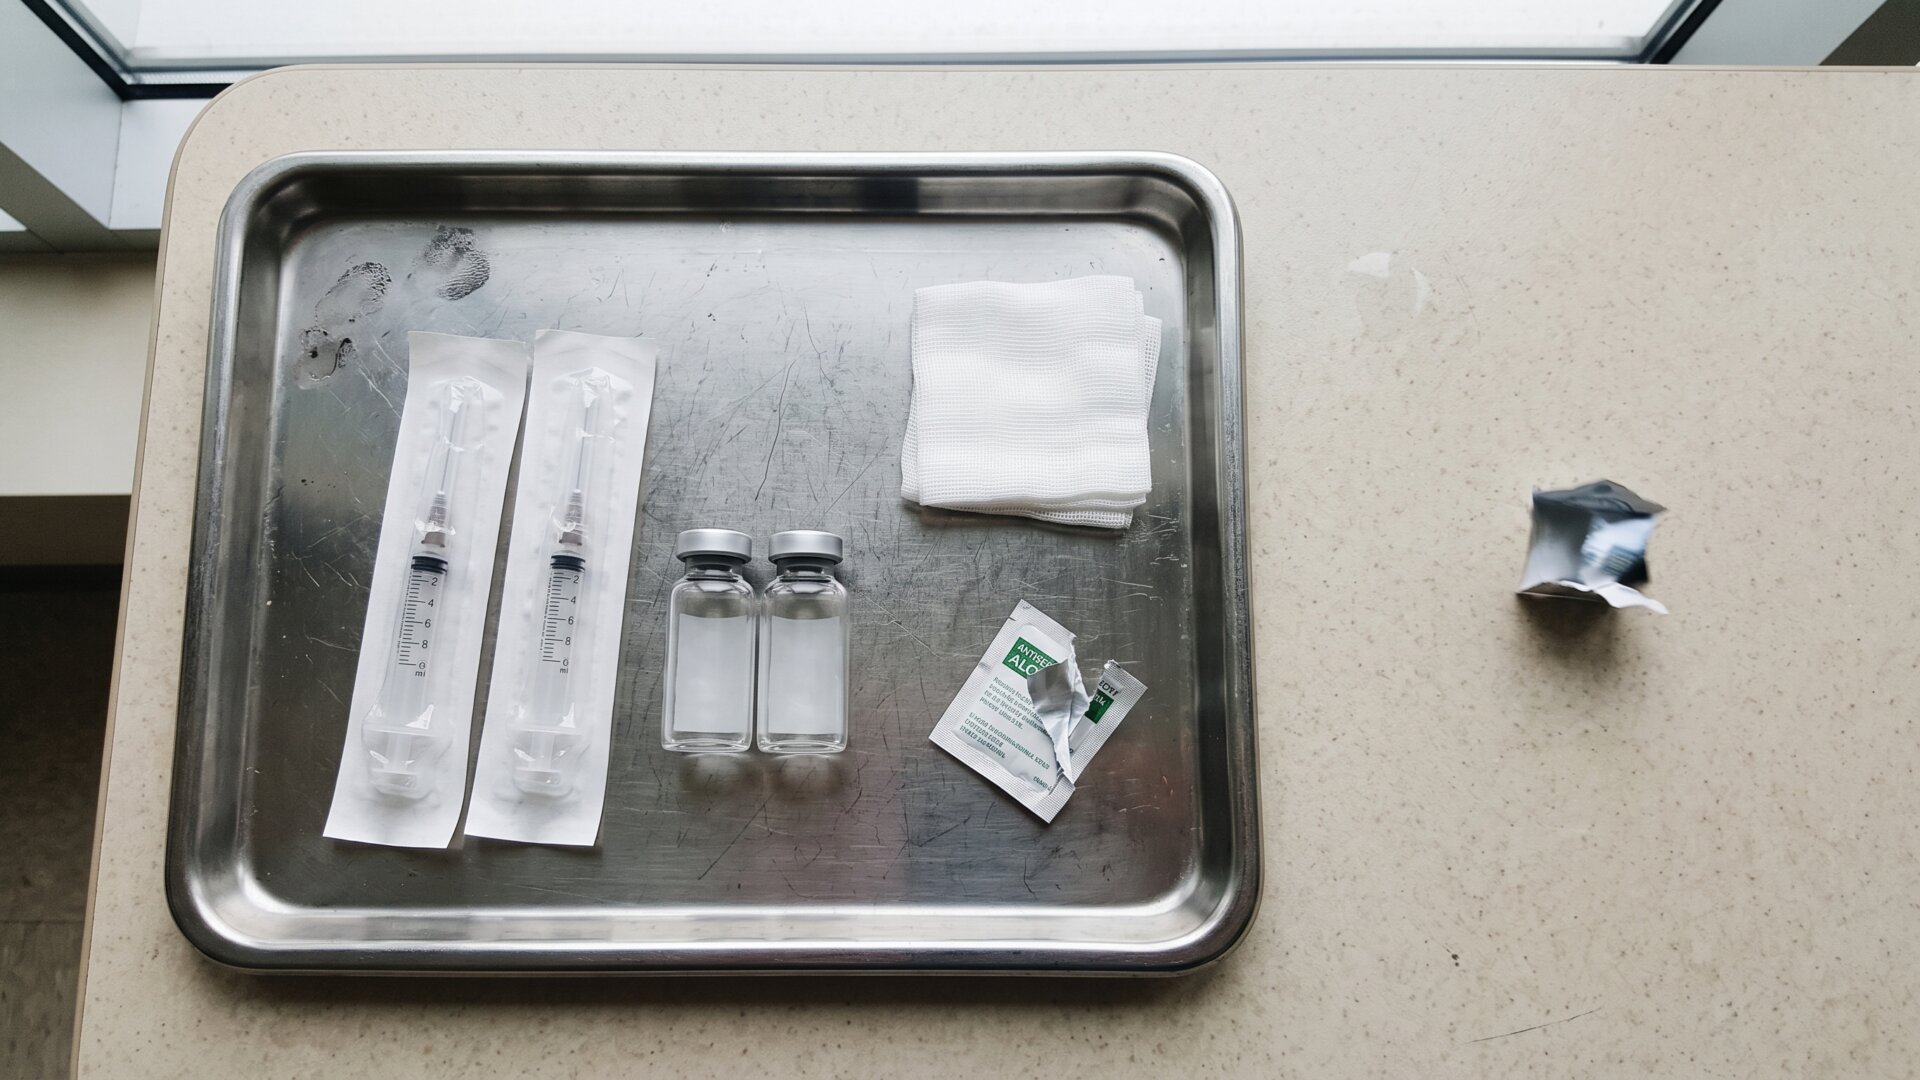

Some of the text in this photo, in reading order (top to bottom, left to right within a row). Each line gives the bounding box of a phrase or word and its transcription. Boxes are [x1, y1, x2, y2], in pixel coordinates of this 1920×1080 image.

[431, 577, 438, 587] 2
[573, 575, 580, 584] 2
[427, 599, 434, 608] 4
[570, 596, 576, 605] 4
[424, 618, 431, 629] 6
[568, 615, 574, 625] 6
[421, 639, 428, 649] 8
[565, 636, 571, 646] 8
